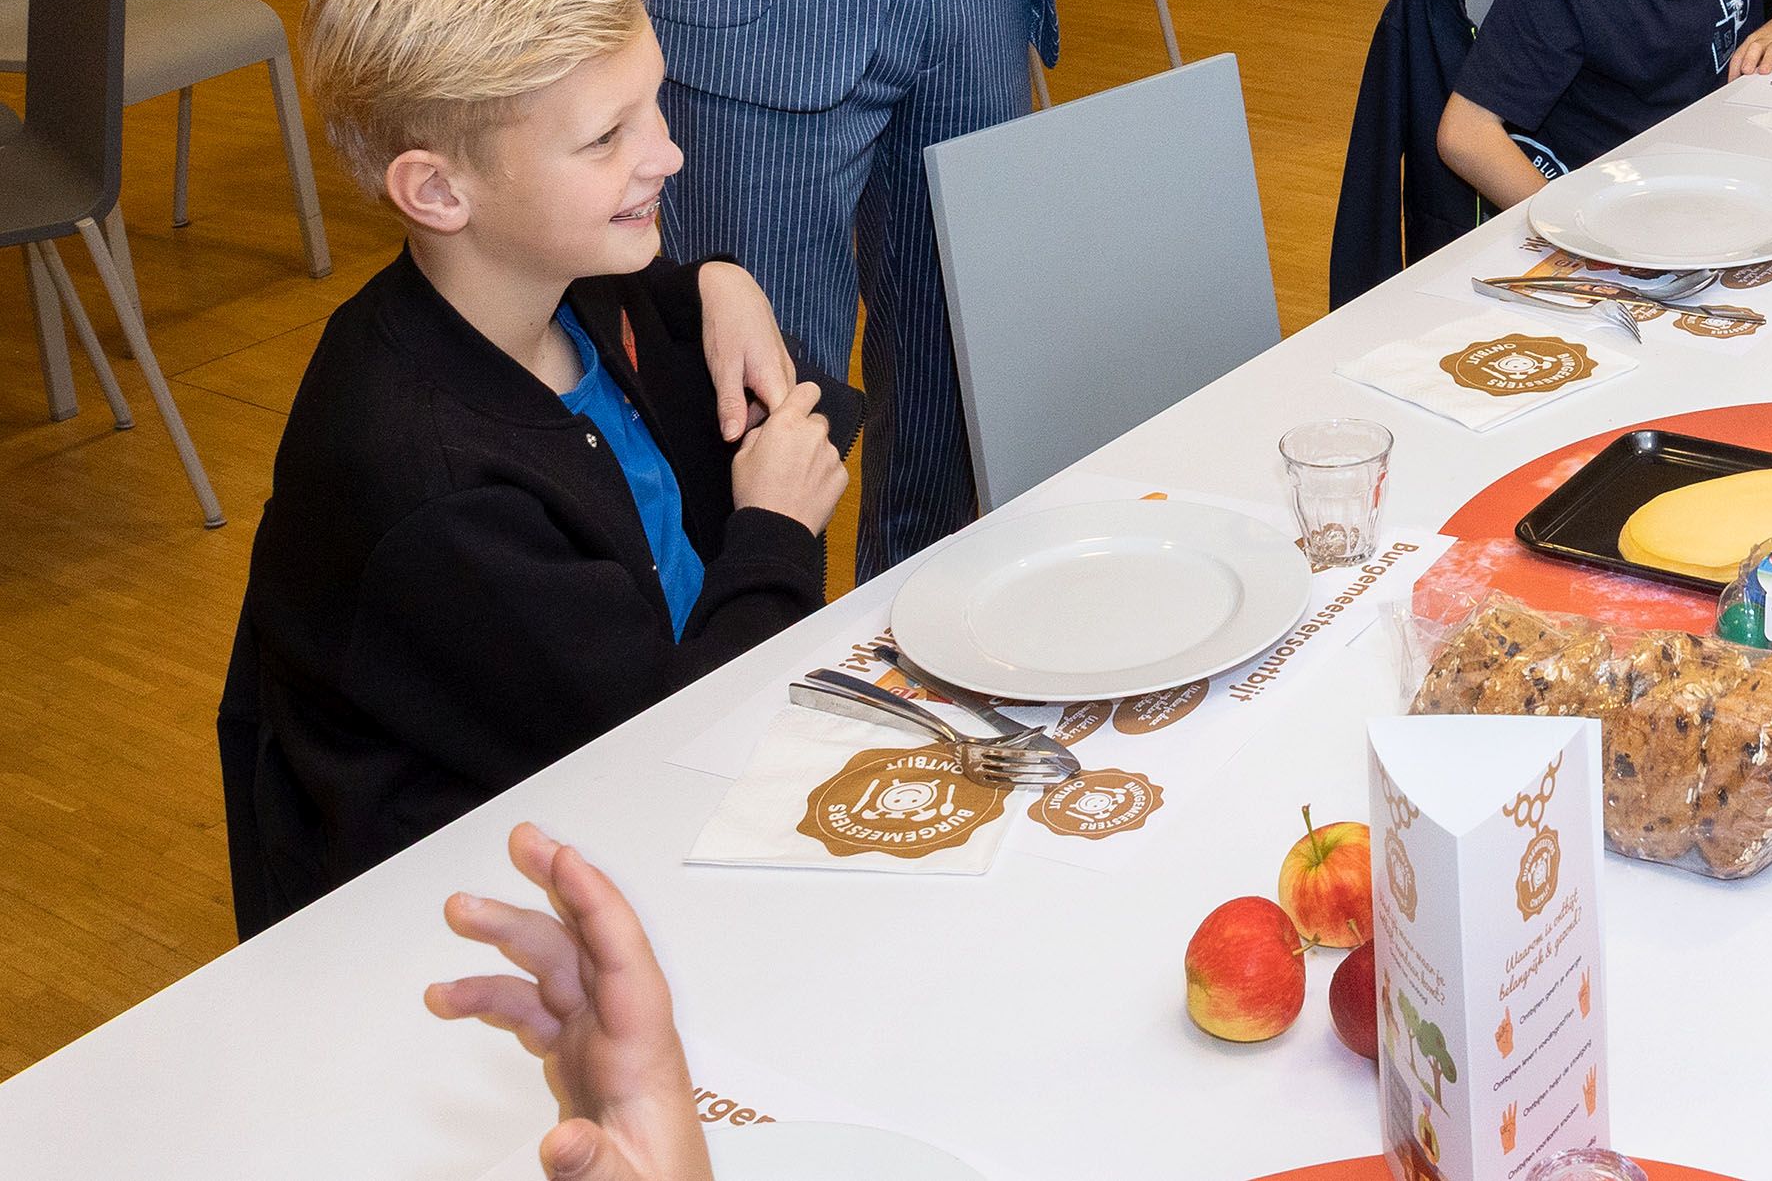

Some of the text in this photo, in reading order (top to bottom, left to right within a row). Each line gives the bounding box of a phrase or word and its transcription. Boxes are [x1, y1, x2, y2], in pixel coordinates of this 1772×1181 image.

[1469, 342, 1518, 366] ONTBIJT
[1228, 541, 1418, 703] Burgemeestersontbijt
[886, 756, 964, 775] ONTBIJT
[1049, 780, 1085, 809] ONTBIJT
[1080, 781, 1146, 830] BURGEMEESTERS
[828, 803, 975, 843] BURGEMEESTERS
